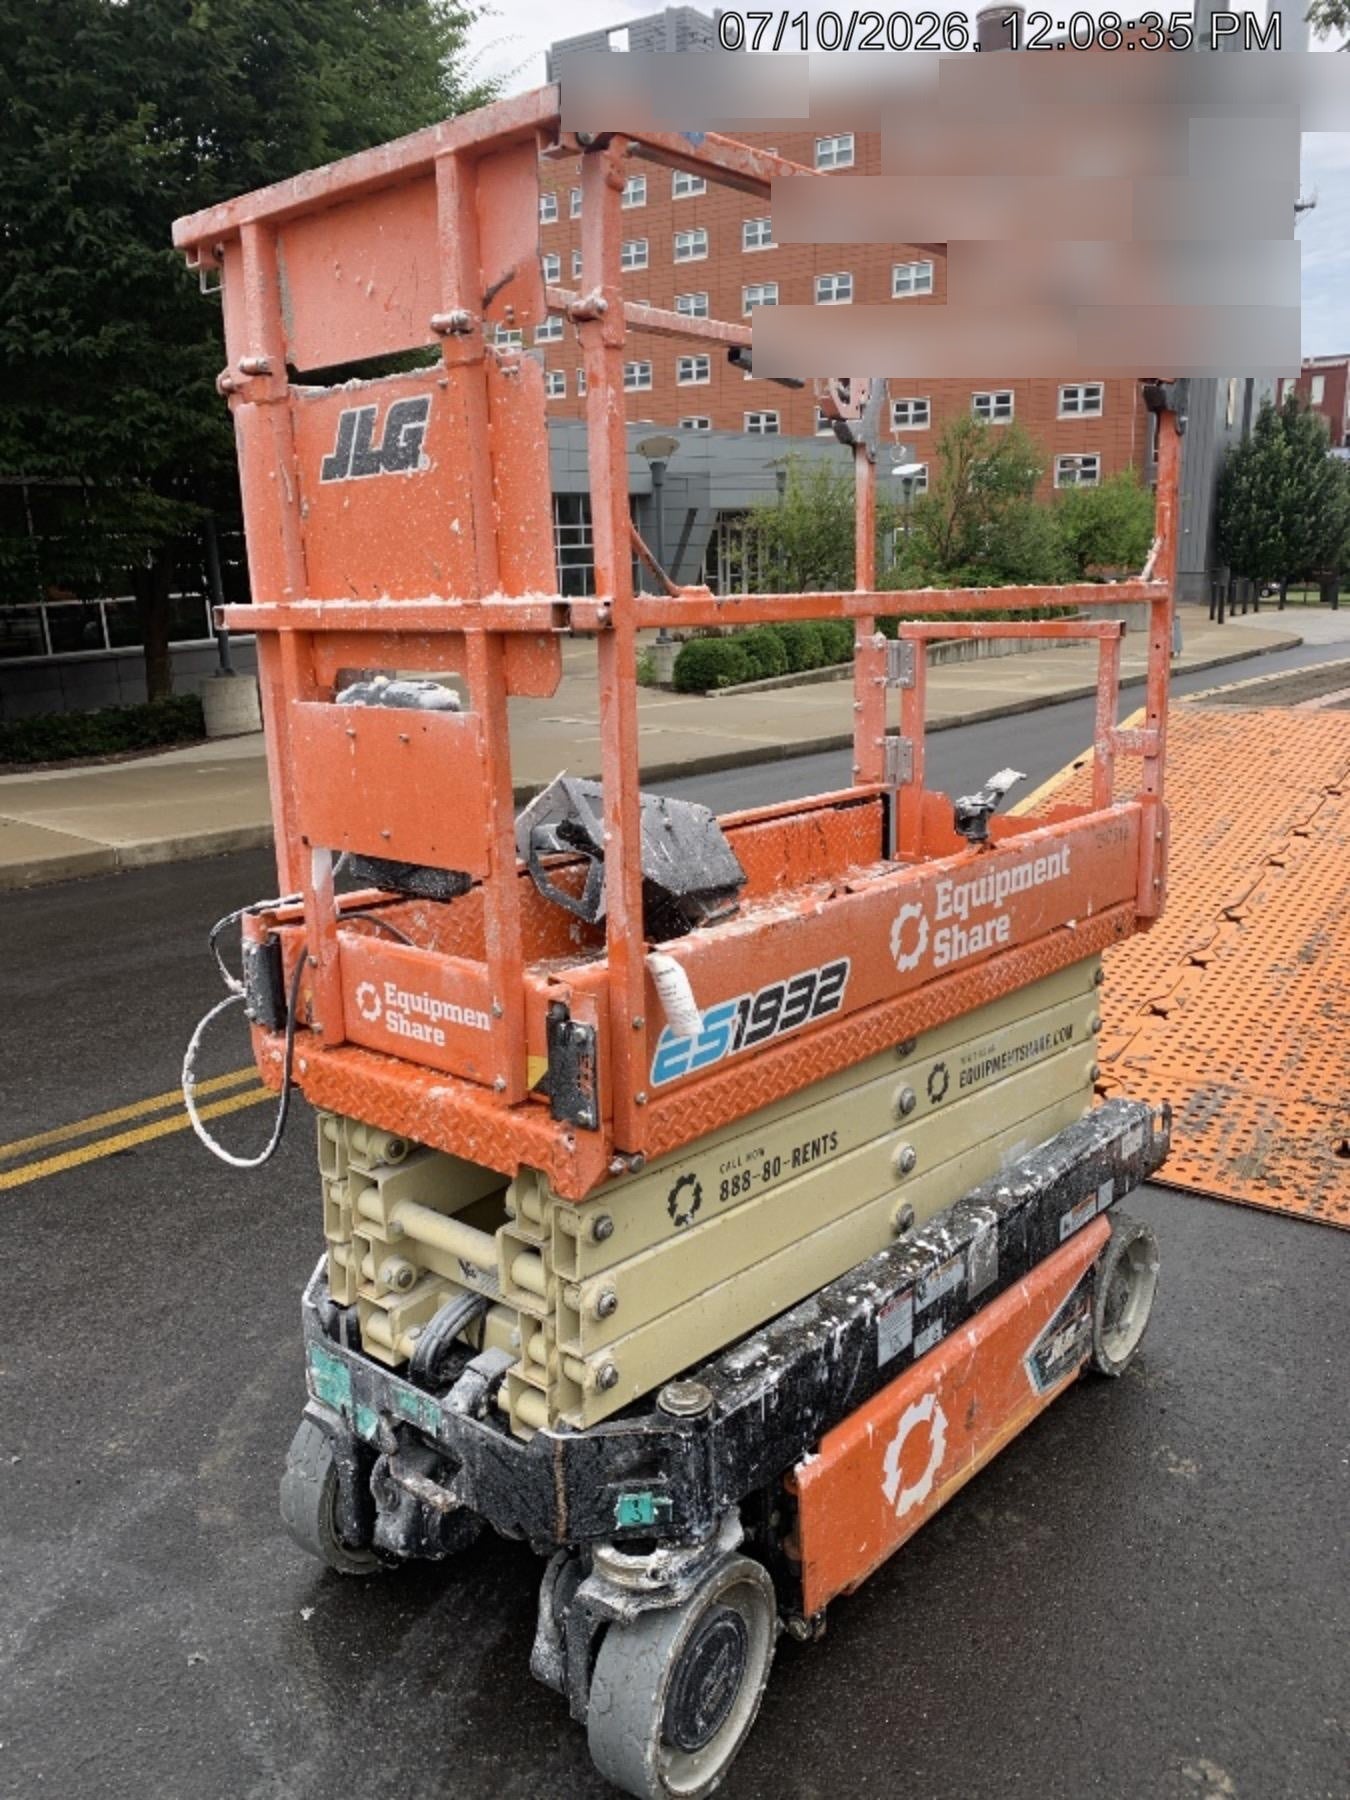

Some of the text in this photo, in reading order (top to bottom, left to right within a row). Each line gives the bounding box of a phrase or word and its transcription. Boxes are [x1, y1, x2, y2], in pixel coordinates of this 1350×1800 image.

[320, 394, 432, 484] JLG
[934, 844, 1071, 922] Equipment
[933, 914, 1010, 969] Share
[383, 981, 491, 1031] Equipmen
[386, 1009, 446, 1047] Share
[650, 956, 851, 1088] ES1932
[719, 1156, 743, 1175] CALL
[719, 1130, 838, 1202] 888-80-RENTS
